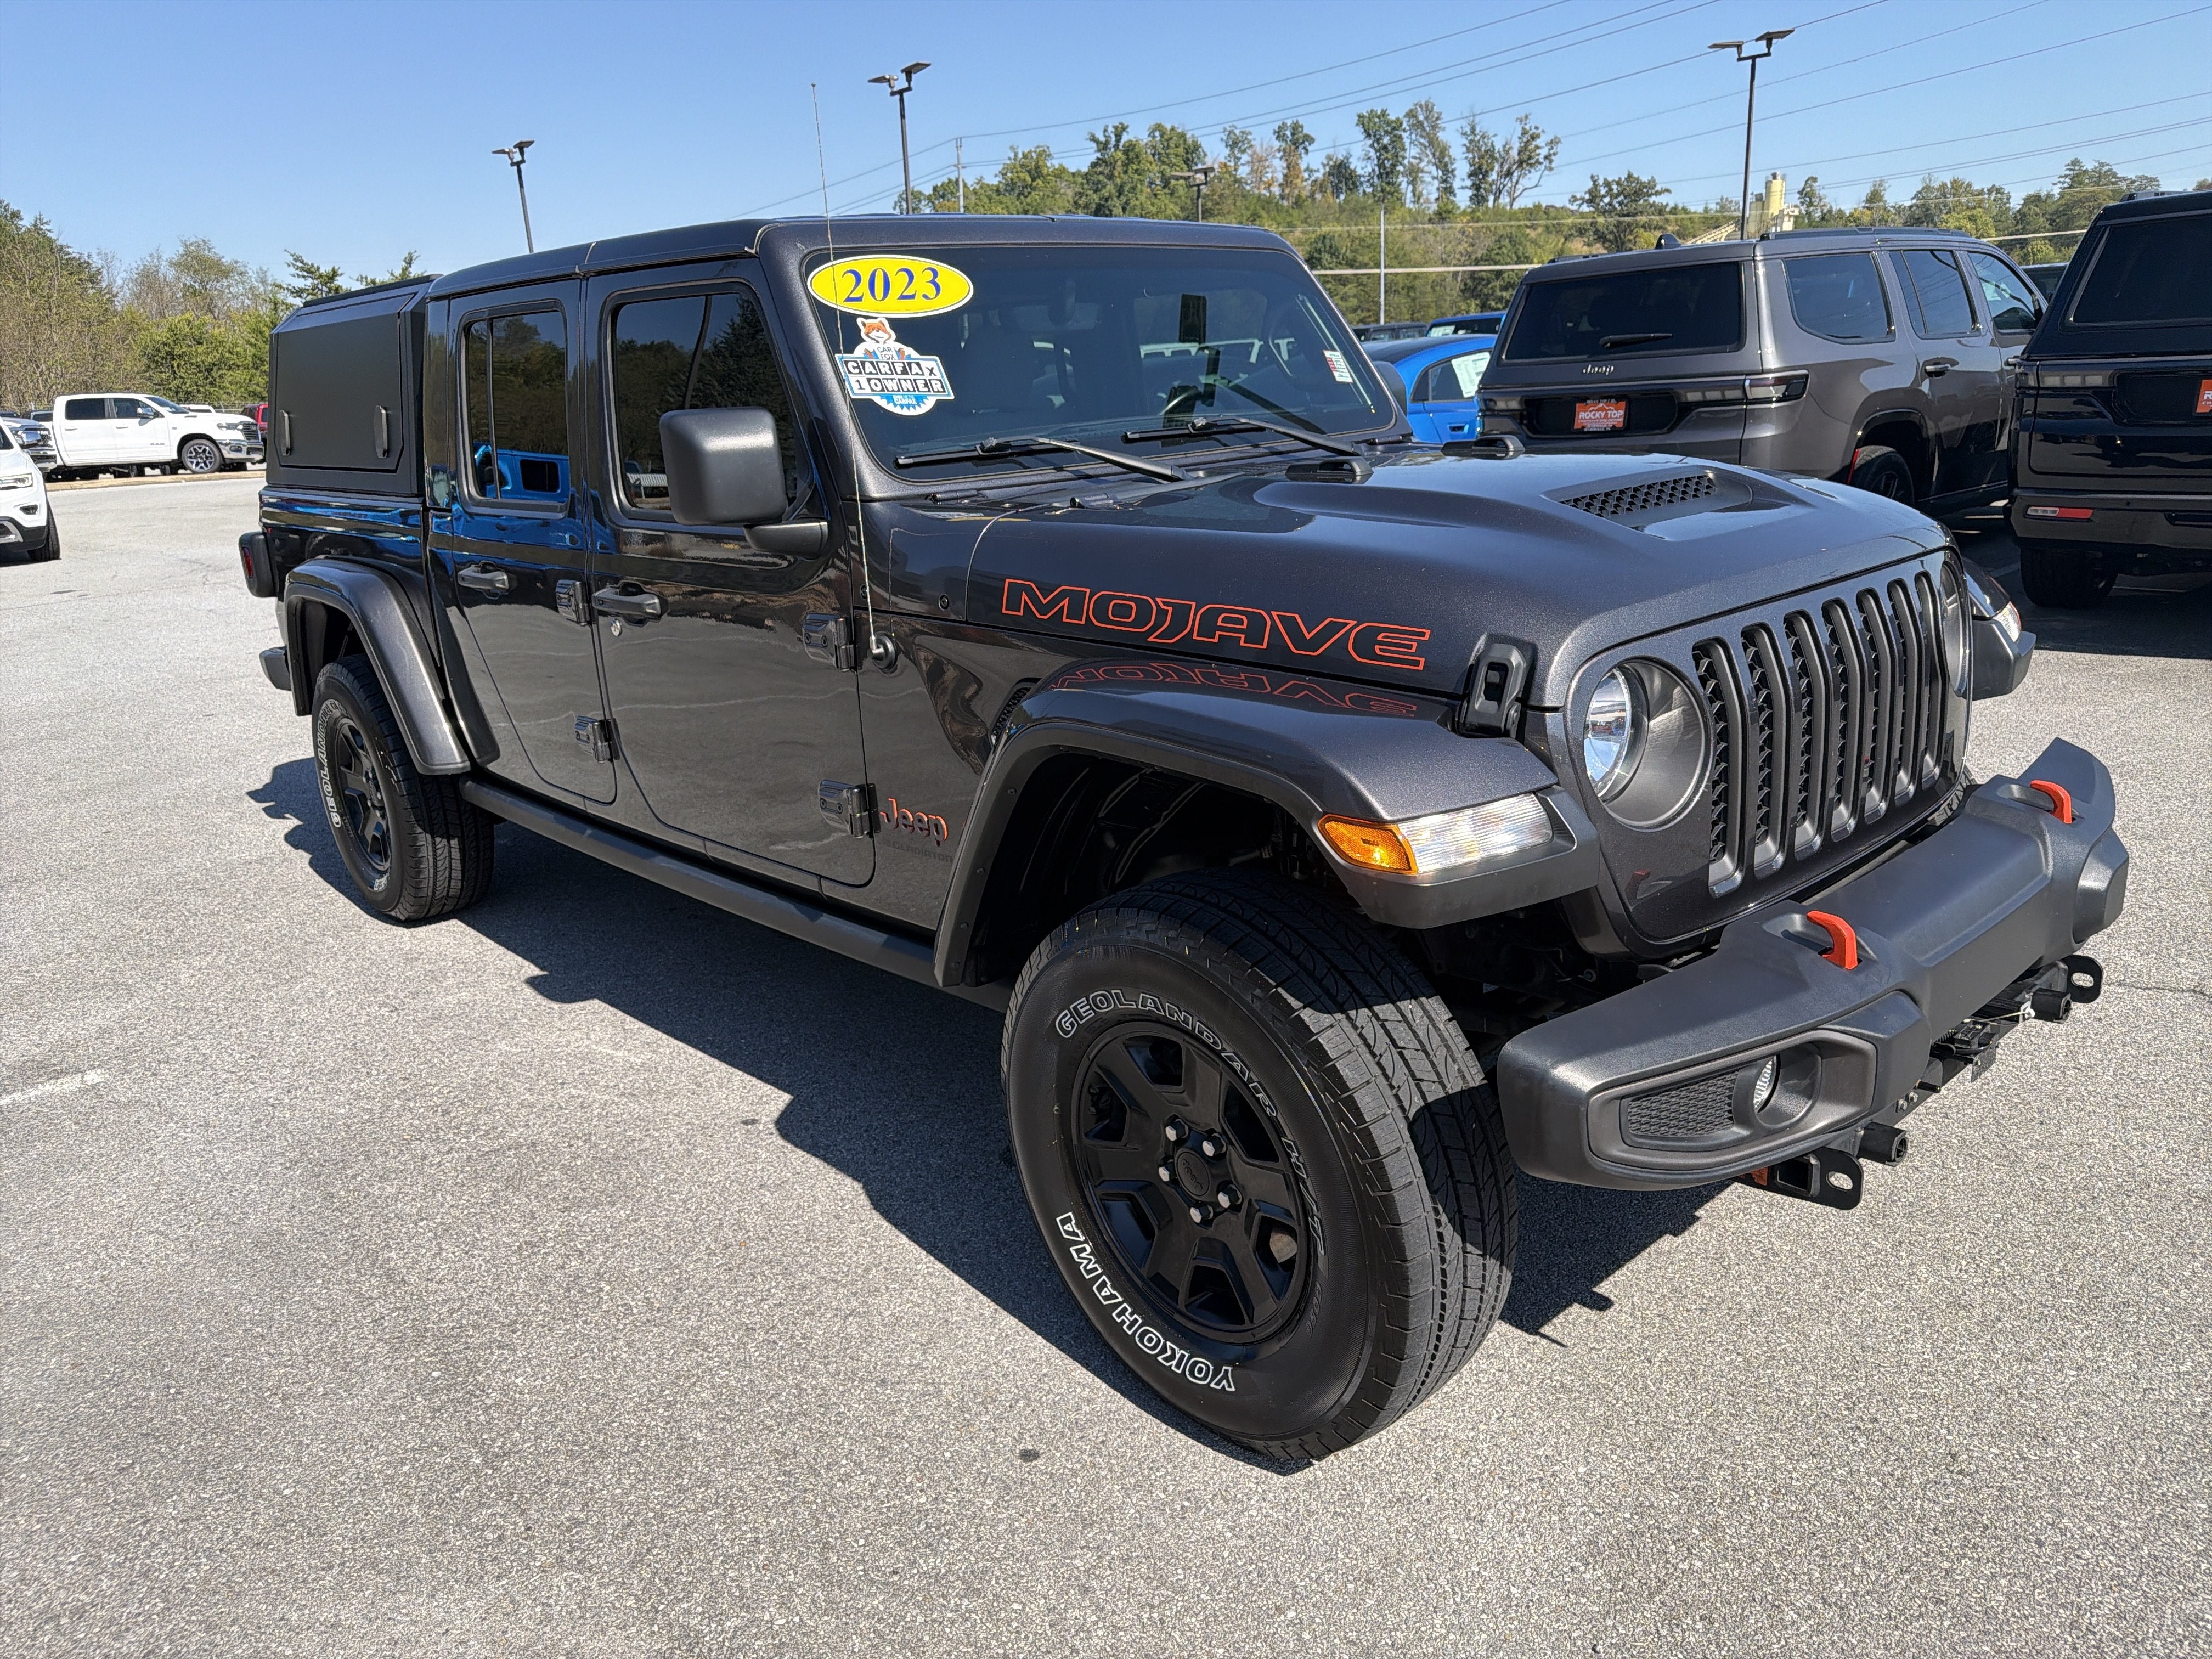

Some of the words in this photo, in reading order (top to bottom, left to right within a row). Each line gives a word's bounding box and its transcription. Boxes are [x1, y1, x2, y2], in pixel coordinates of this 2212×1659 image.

[841, 267, 941, 303] 2023
[846, 360, 938, 377] CARFAX
[854, 379, 865, 390] 1
[866, 377, 947, 393] OWNER
[1579, 411, 1606, 419] ROCKY
[1607, 410, 1624, 419] TOP
[1001, 578, 1430, 670] MOJAVE
[880, 798, 948, 847] Jeep
[1055, 990, 1277, 1119] GEOLANDAR
[1281, 1136, 1326, 1256] H/T
[1056, 1212, 1237, 1392] YOKOHAMA
